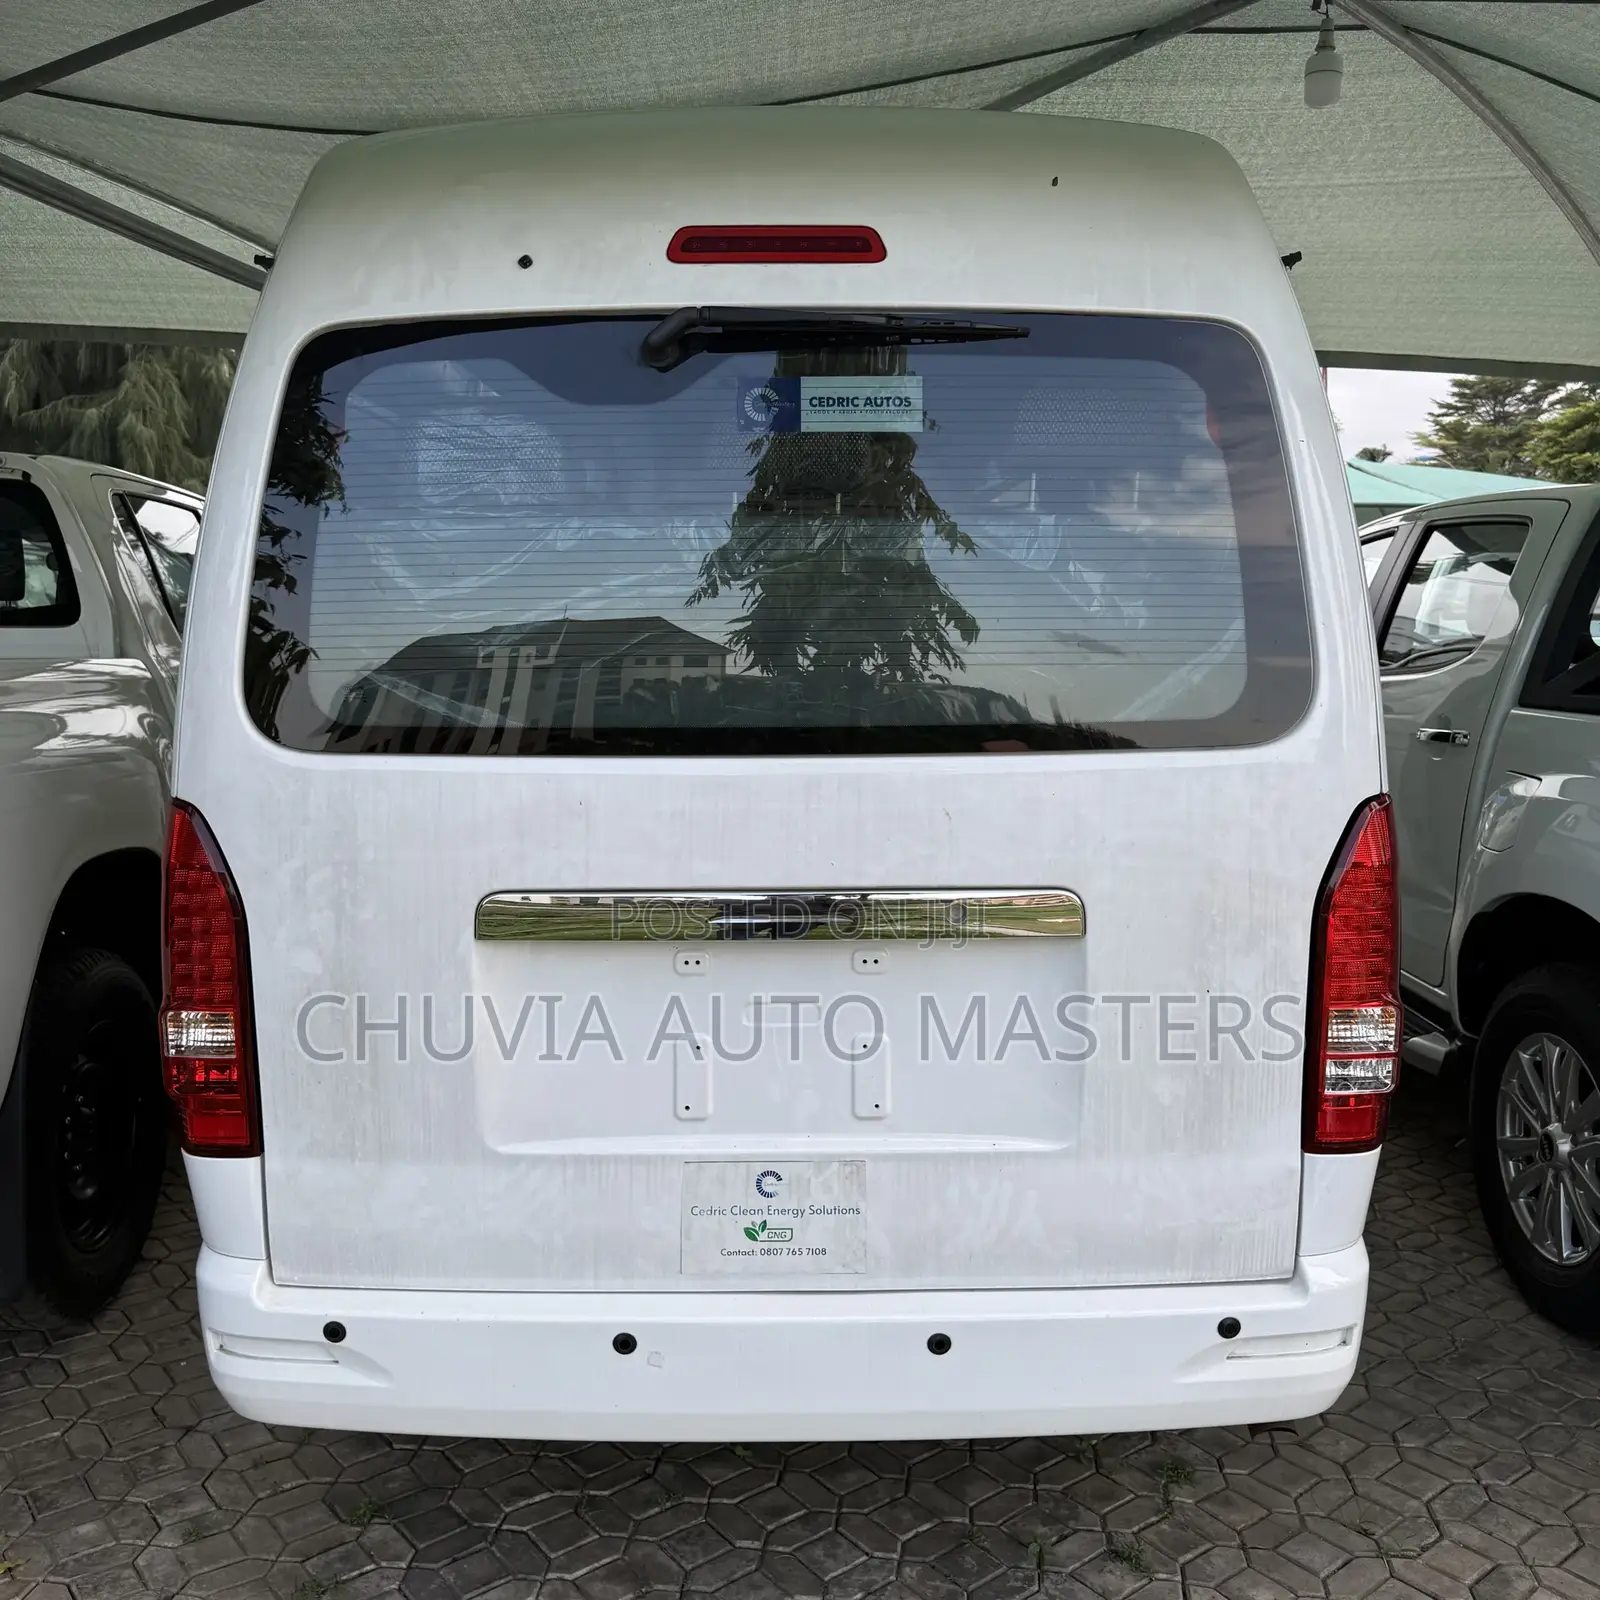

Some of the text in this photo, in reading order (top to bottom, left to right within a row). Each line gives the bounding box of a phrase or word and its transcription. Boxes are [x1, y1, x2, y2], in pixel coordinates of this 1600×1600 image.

[808, 396, 912, 408] CEDRIC AUTOS
[690, 1204, 861, 1218] Cedric Clean Energy Solutions
[767, 1231, 787, 1239] CNG
[720, 1247, 827, 1257] Contact: 0807 765 7108
